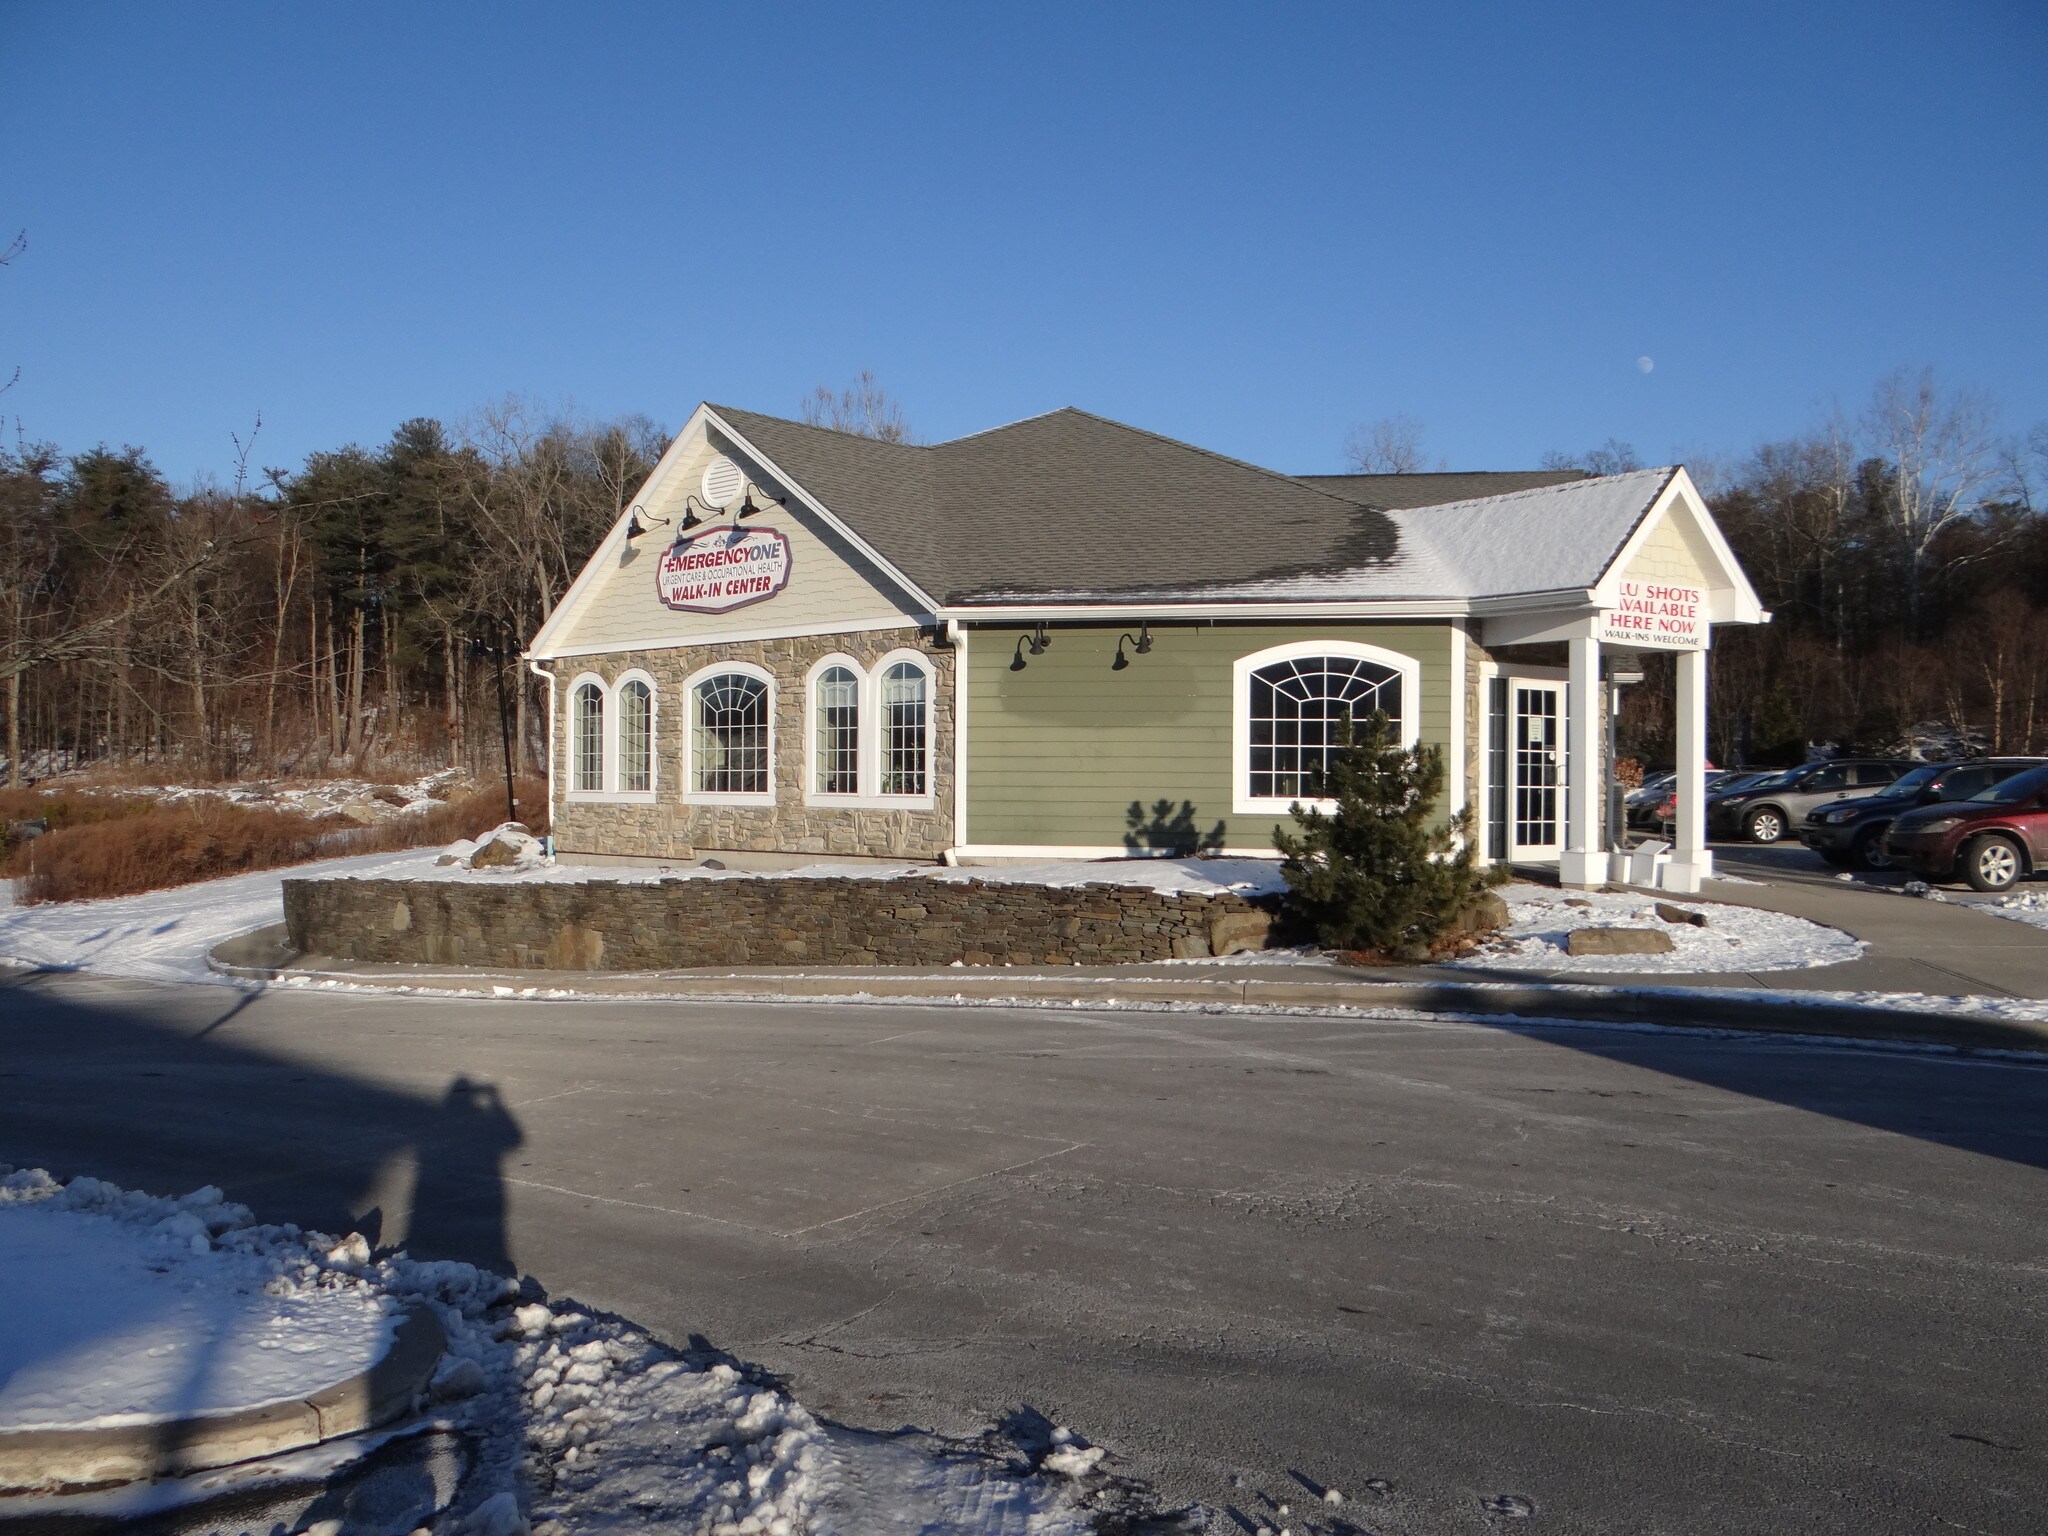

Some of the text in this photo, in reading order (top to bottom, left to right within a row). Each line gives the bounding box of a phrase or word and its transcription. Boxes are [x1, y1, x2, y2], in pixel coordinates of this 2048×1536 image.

[662, 573, 686, 586] URGENT
[686, 571, 702, 583] CARE
[707, 565, 756, 580] OCCUPATIONAL
[758, 561, 783, 574] HEALTH
[672, 576, 771, 602] WALK-IN CENTER
[1619, 582, 1699, 603] LU SHOTS
[1610, 613, 1696, 634] HERE NOW
[1604, 630, 1700, 646] WALK-INS WELCOME
